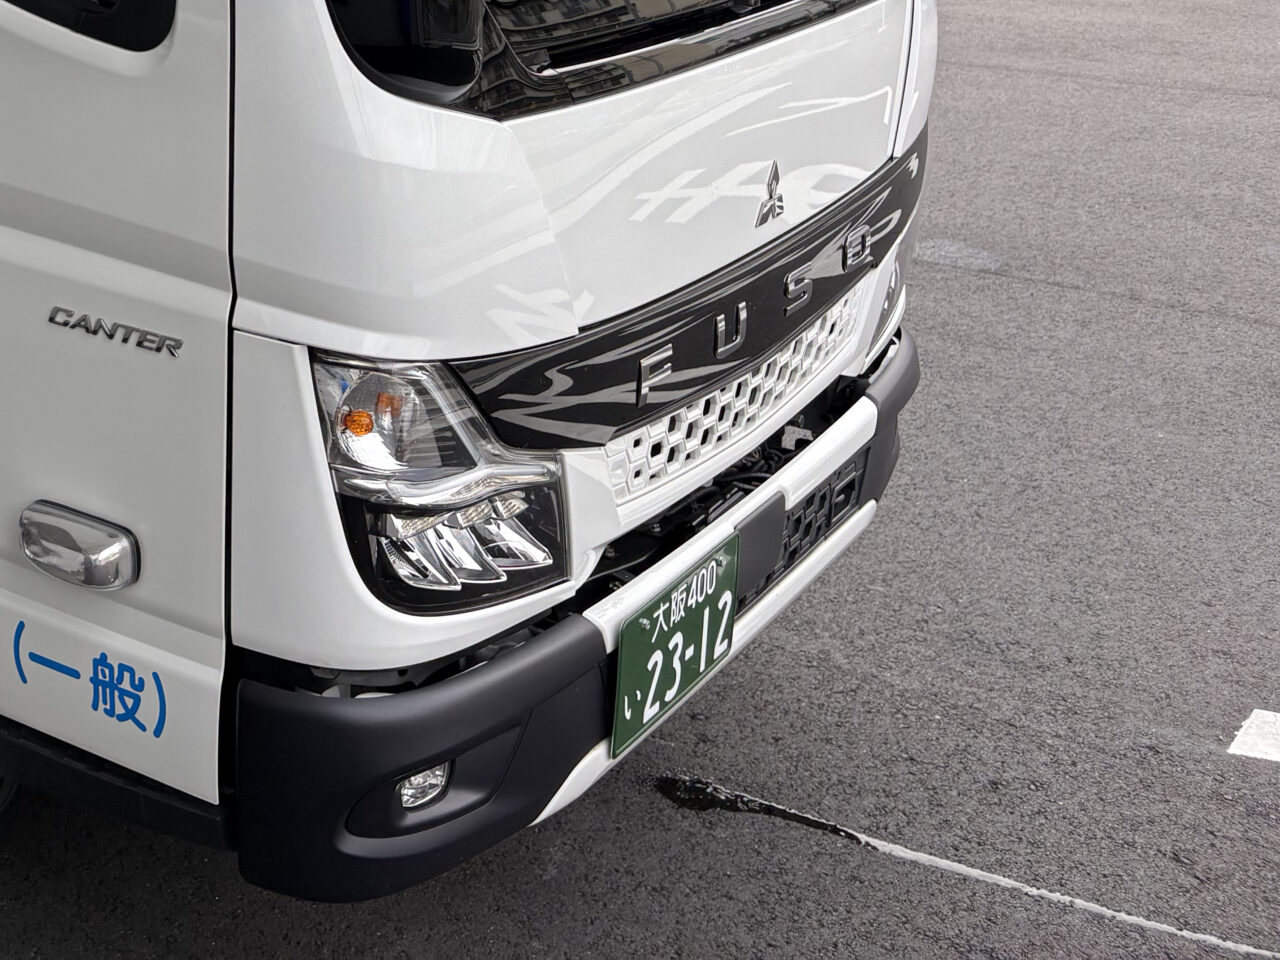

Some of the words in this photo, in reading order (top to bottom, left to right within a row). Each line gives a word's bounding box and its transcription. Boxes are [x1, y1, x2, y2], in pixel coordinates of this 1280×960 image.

[48, 305, 185, 358] CANTER
[635, 224, 872, 408] FUSO
[624, 690, 642, 721] い
[643, 590, 733, 725] 23-12
[652, 560, 718, 644] 大阪400
[13, 619, 167, 739] (一般)
